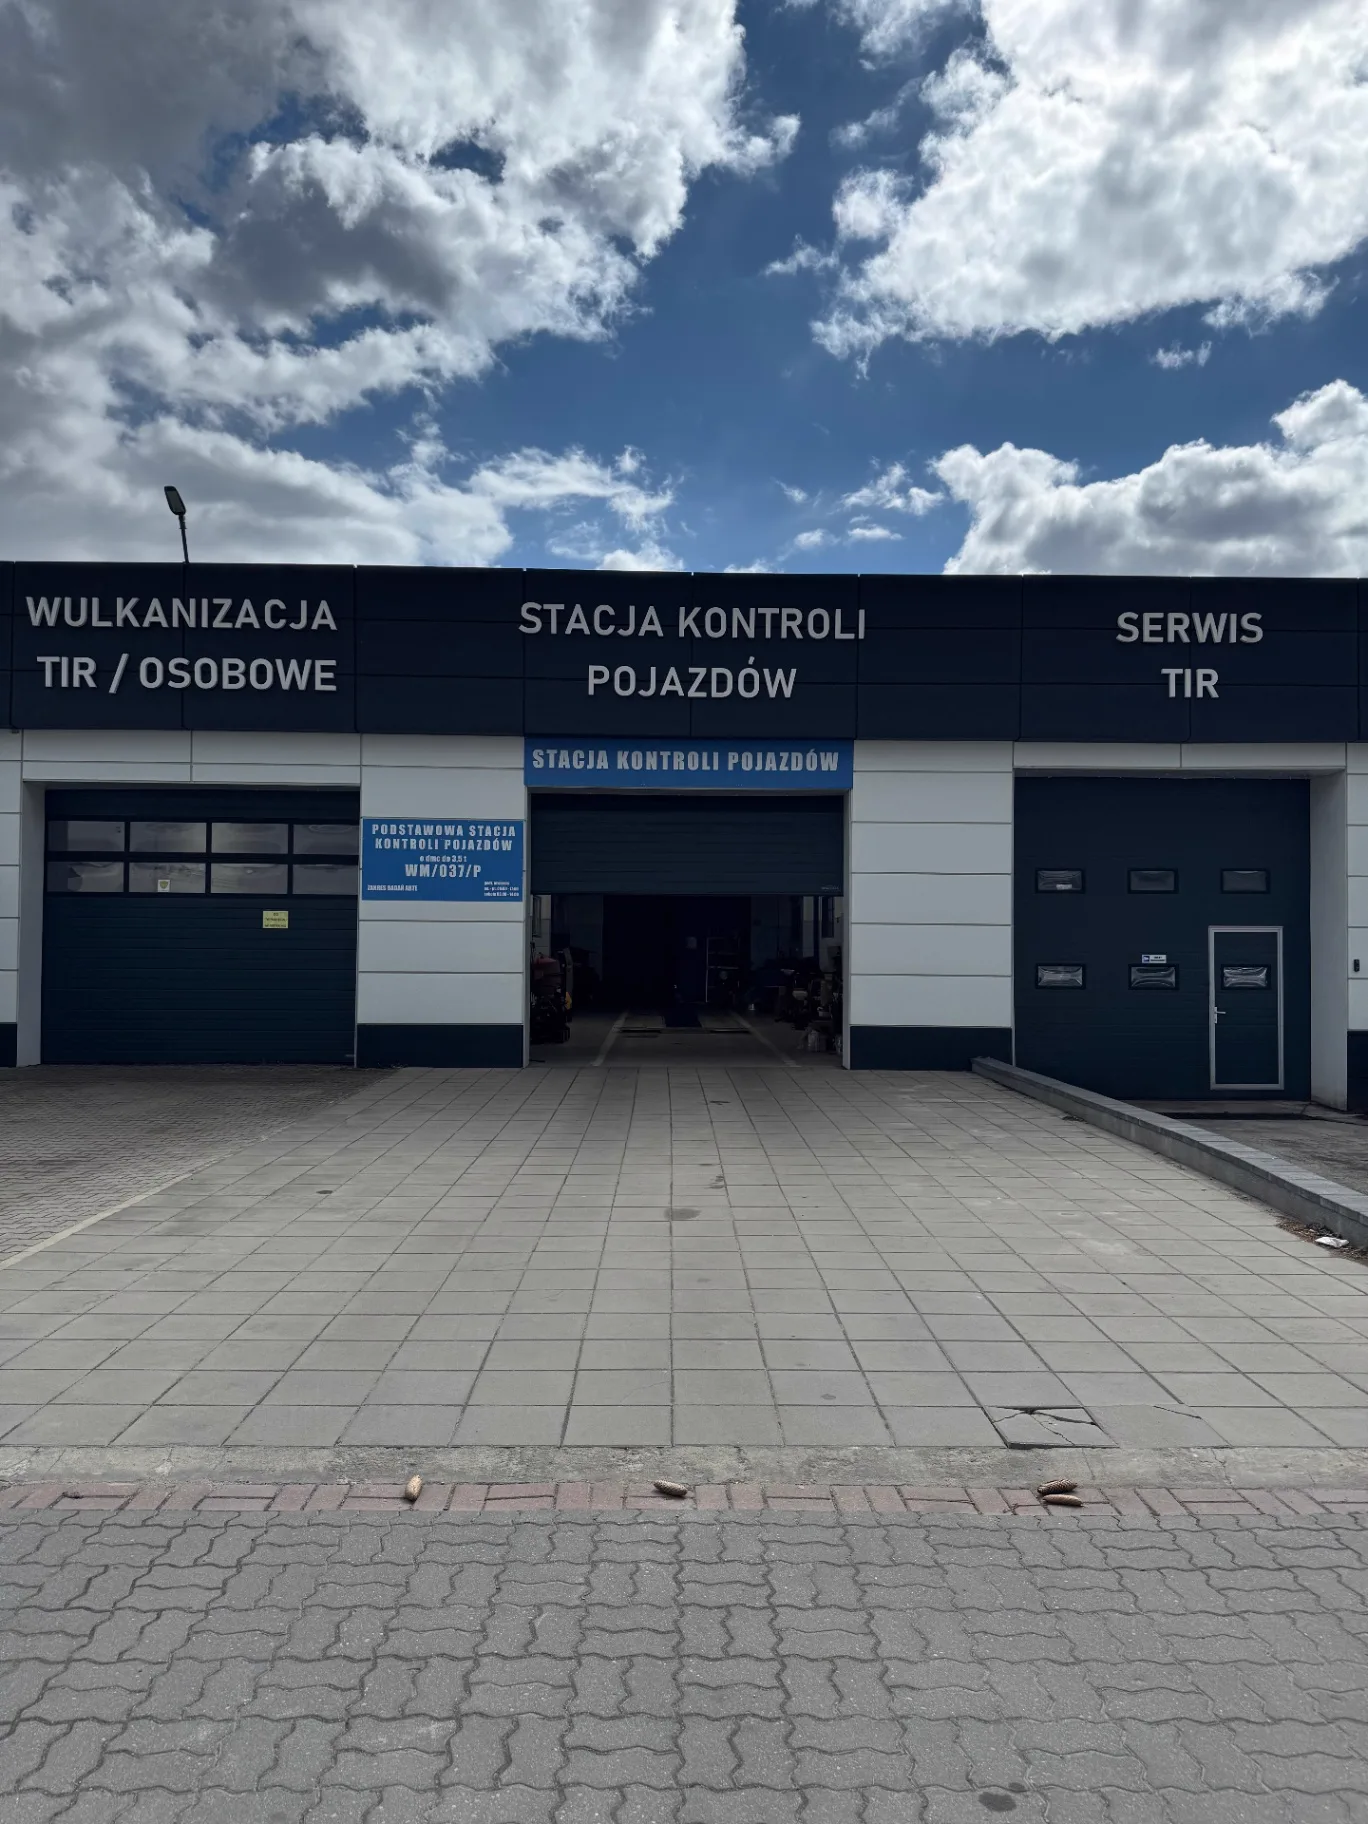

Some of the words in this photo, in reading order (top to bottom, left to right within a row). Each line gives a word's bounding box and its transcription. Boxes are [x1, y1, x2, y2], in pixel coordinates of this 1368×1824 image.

[26, 596, 338, 631] WULKANIZACJA
[518, 602, 664, 637] STACJA
[678, 606, 867, 640] KONTROLI
[1115, 611, 1264, 644] SERWIS
[36, 655, 97, 689] TIR
[109, 653, 130, 695] /
[139, 656, 337, 692] OSOBOWE
[588, 656, 797, 699] POJAZDÓW
[1160, 668, 1220, 698] TIR
[532, 748, 609, 770] STACJA
[616, 749, 719, 771] KONTROLI
[727, 748, 839, 772] POJAZDÓW
[371, 824, 464, 836] PODSTAWOWA
[468, 825, 516, 837] STACJA
[375, 838, 439, 850] KONTROLI
[444, 838, 513, 851] POJAZDÓW
[404, 863, 482, 878] WM/037/P
